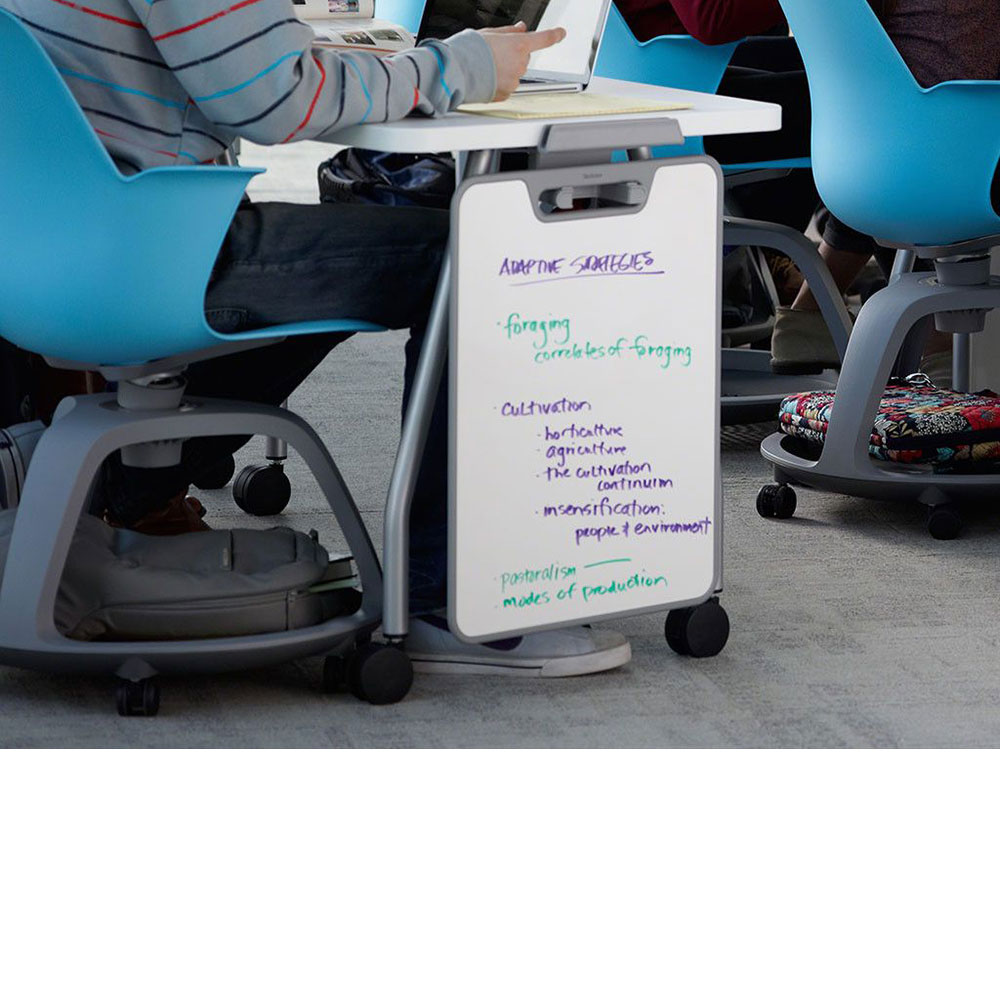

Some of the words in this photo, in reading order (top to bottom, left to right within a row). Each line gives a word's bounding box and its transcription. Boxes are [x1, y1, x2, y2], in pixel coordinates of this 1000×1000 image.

[499, 257, 565, 276] ADAPTIVE
[569, 251, 655, 274] STRATEGIES
[504, 312, 570, 349] foraging
[534, 341, 604, 363] correlates
[607, 336, 629, 357] of
[629, 335, 692, 369] foraging
[545, 423, 624, 441] horticulture
[546, 442, 627, 467] agriculture
[544, 465, 571, 481] the
[576, 460, 651, 479] cultivation
[575, 523, 620, 546] people
[634, 516, 712, 535] environment
[501, 562, 577, 593] pastoralism
[503, 590, 550, 609] modes
[556, 582, 577, 600] of
[582, 569, 668, 603] production
